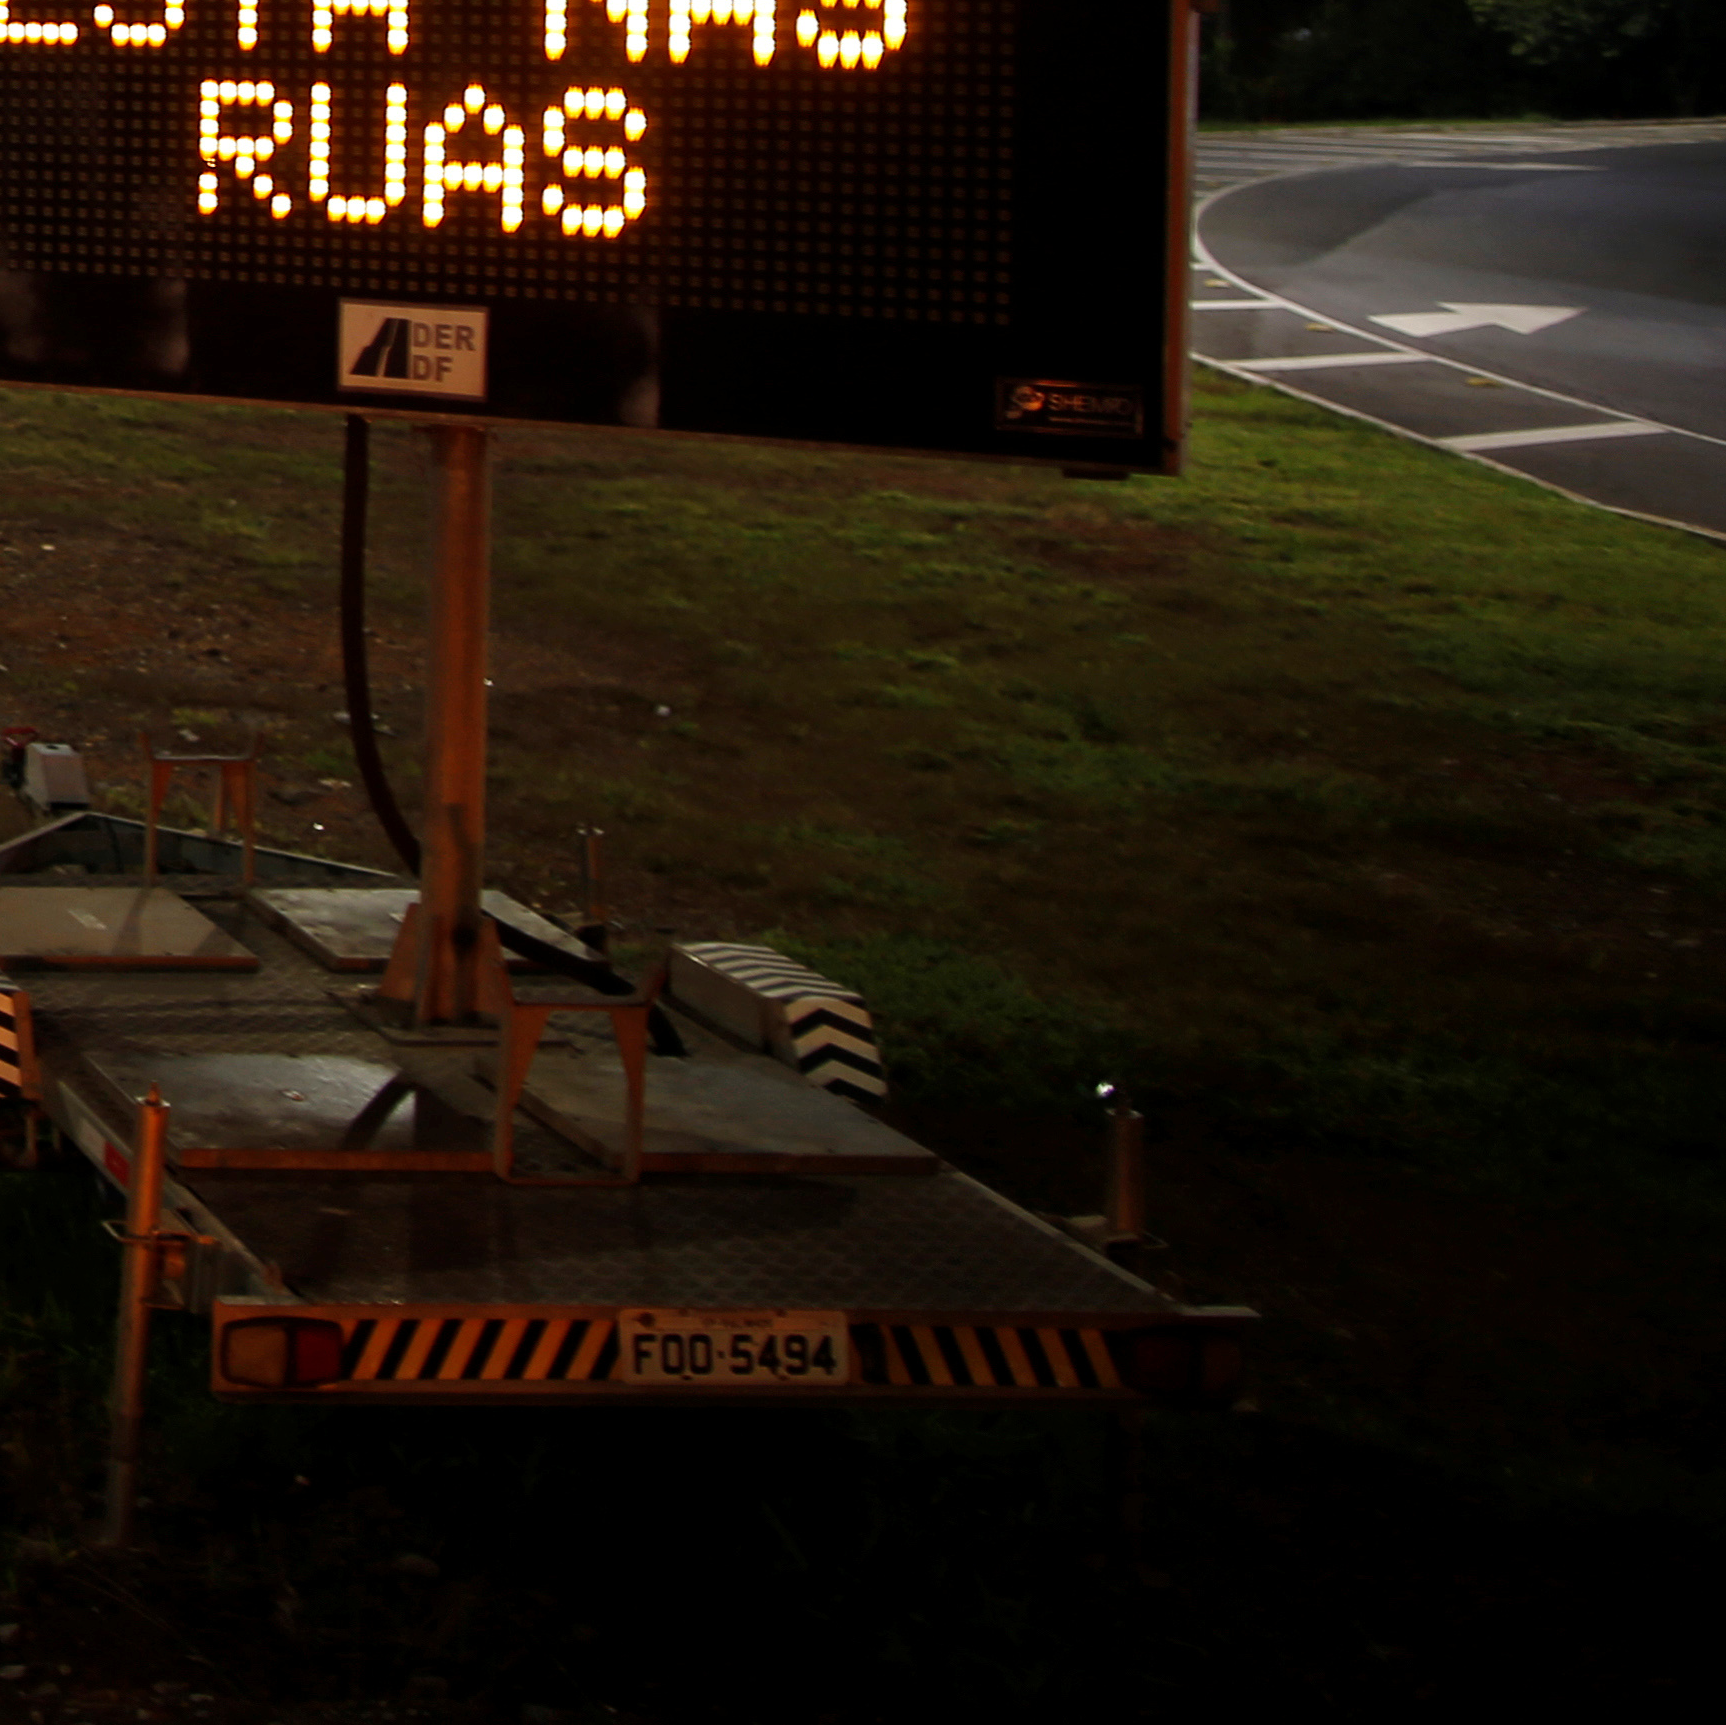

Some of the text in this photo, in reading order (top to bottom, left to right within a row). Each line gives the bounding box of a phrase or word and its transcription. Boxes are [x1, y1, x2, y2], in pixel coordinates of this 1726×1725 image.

[198, 80, 647, 237] RUAS
[413, 322, 475, 351] DER
[413, 354, 453, 382] DF
